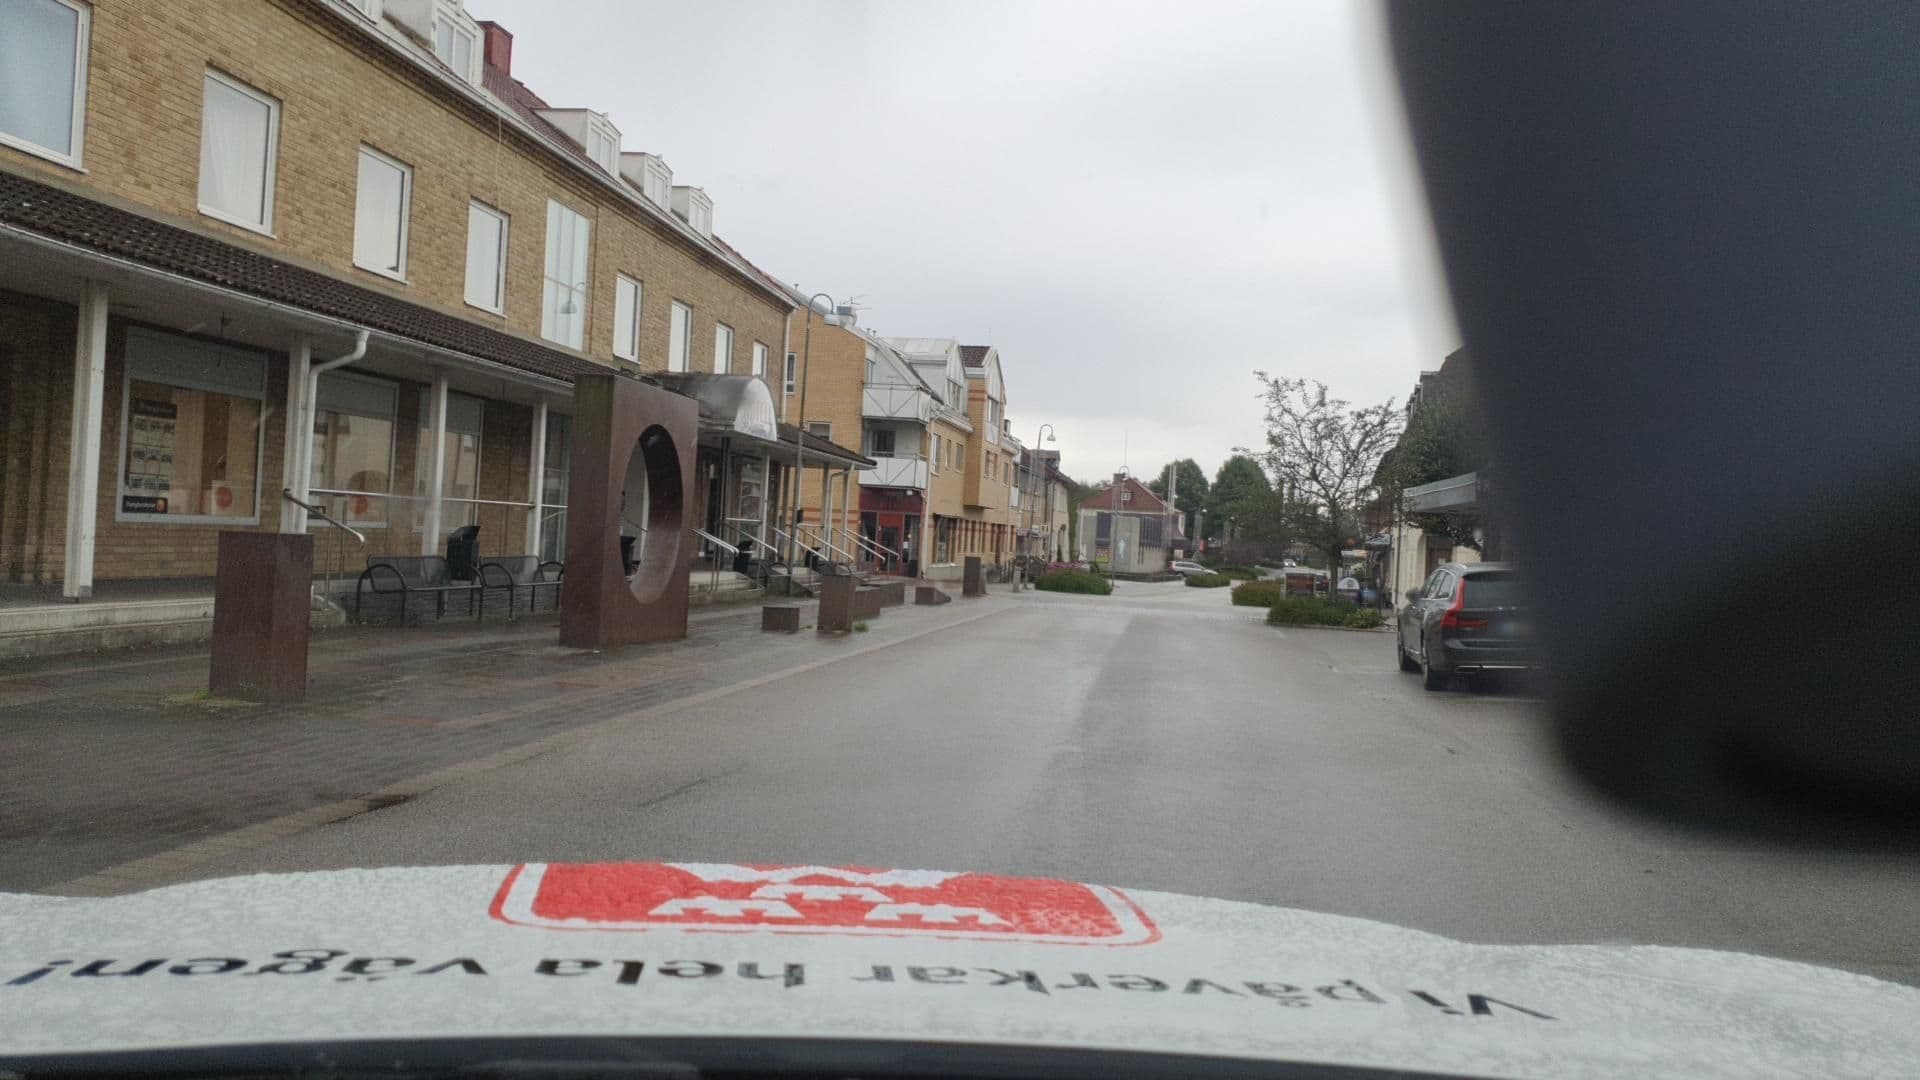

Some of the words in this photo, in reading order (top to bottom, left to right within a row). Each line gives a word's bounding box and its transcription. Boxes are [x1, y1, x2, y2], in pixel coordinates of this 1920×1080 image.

[4, 949, 488, 985] vägen!
[534, 959, 805, 988] hela
[850, 964, 1388, 1007] påverkar
[1409, 989, 1560, 1020] Vi
